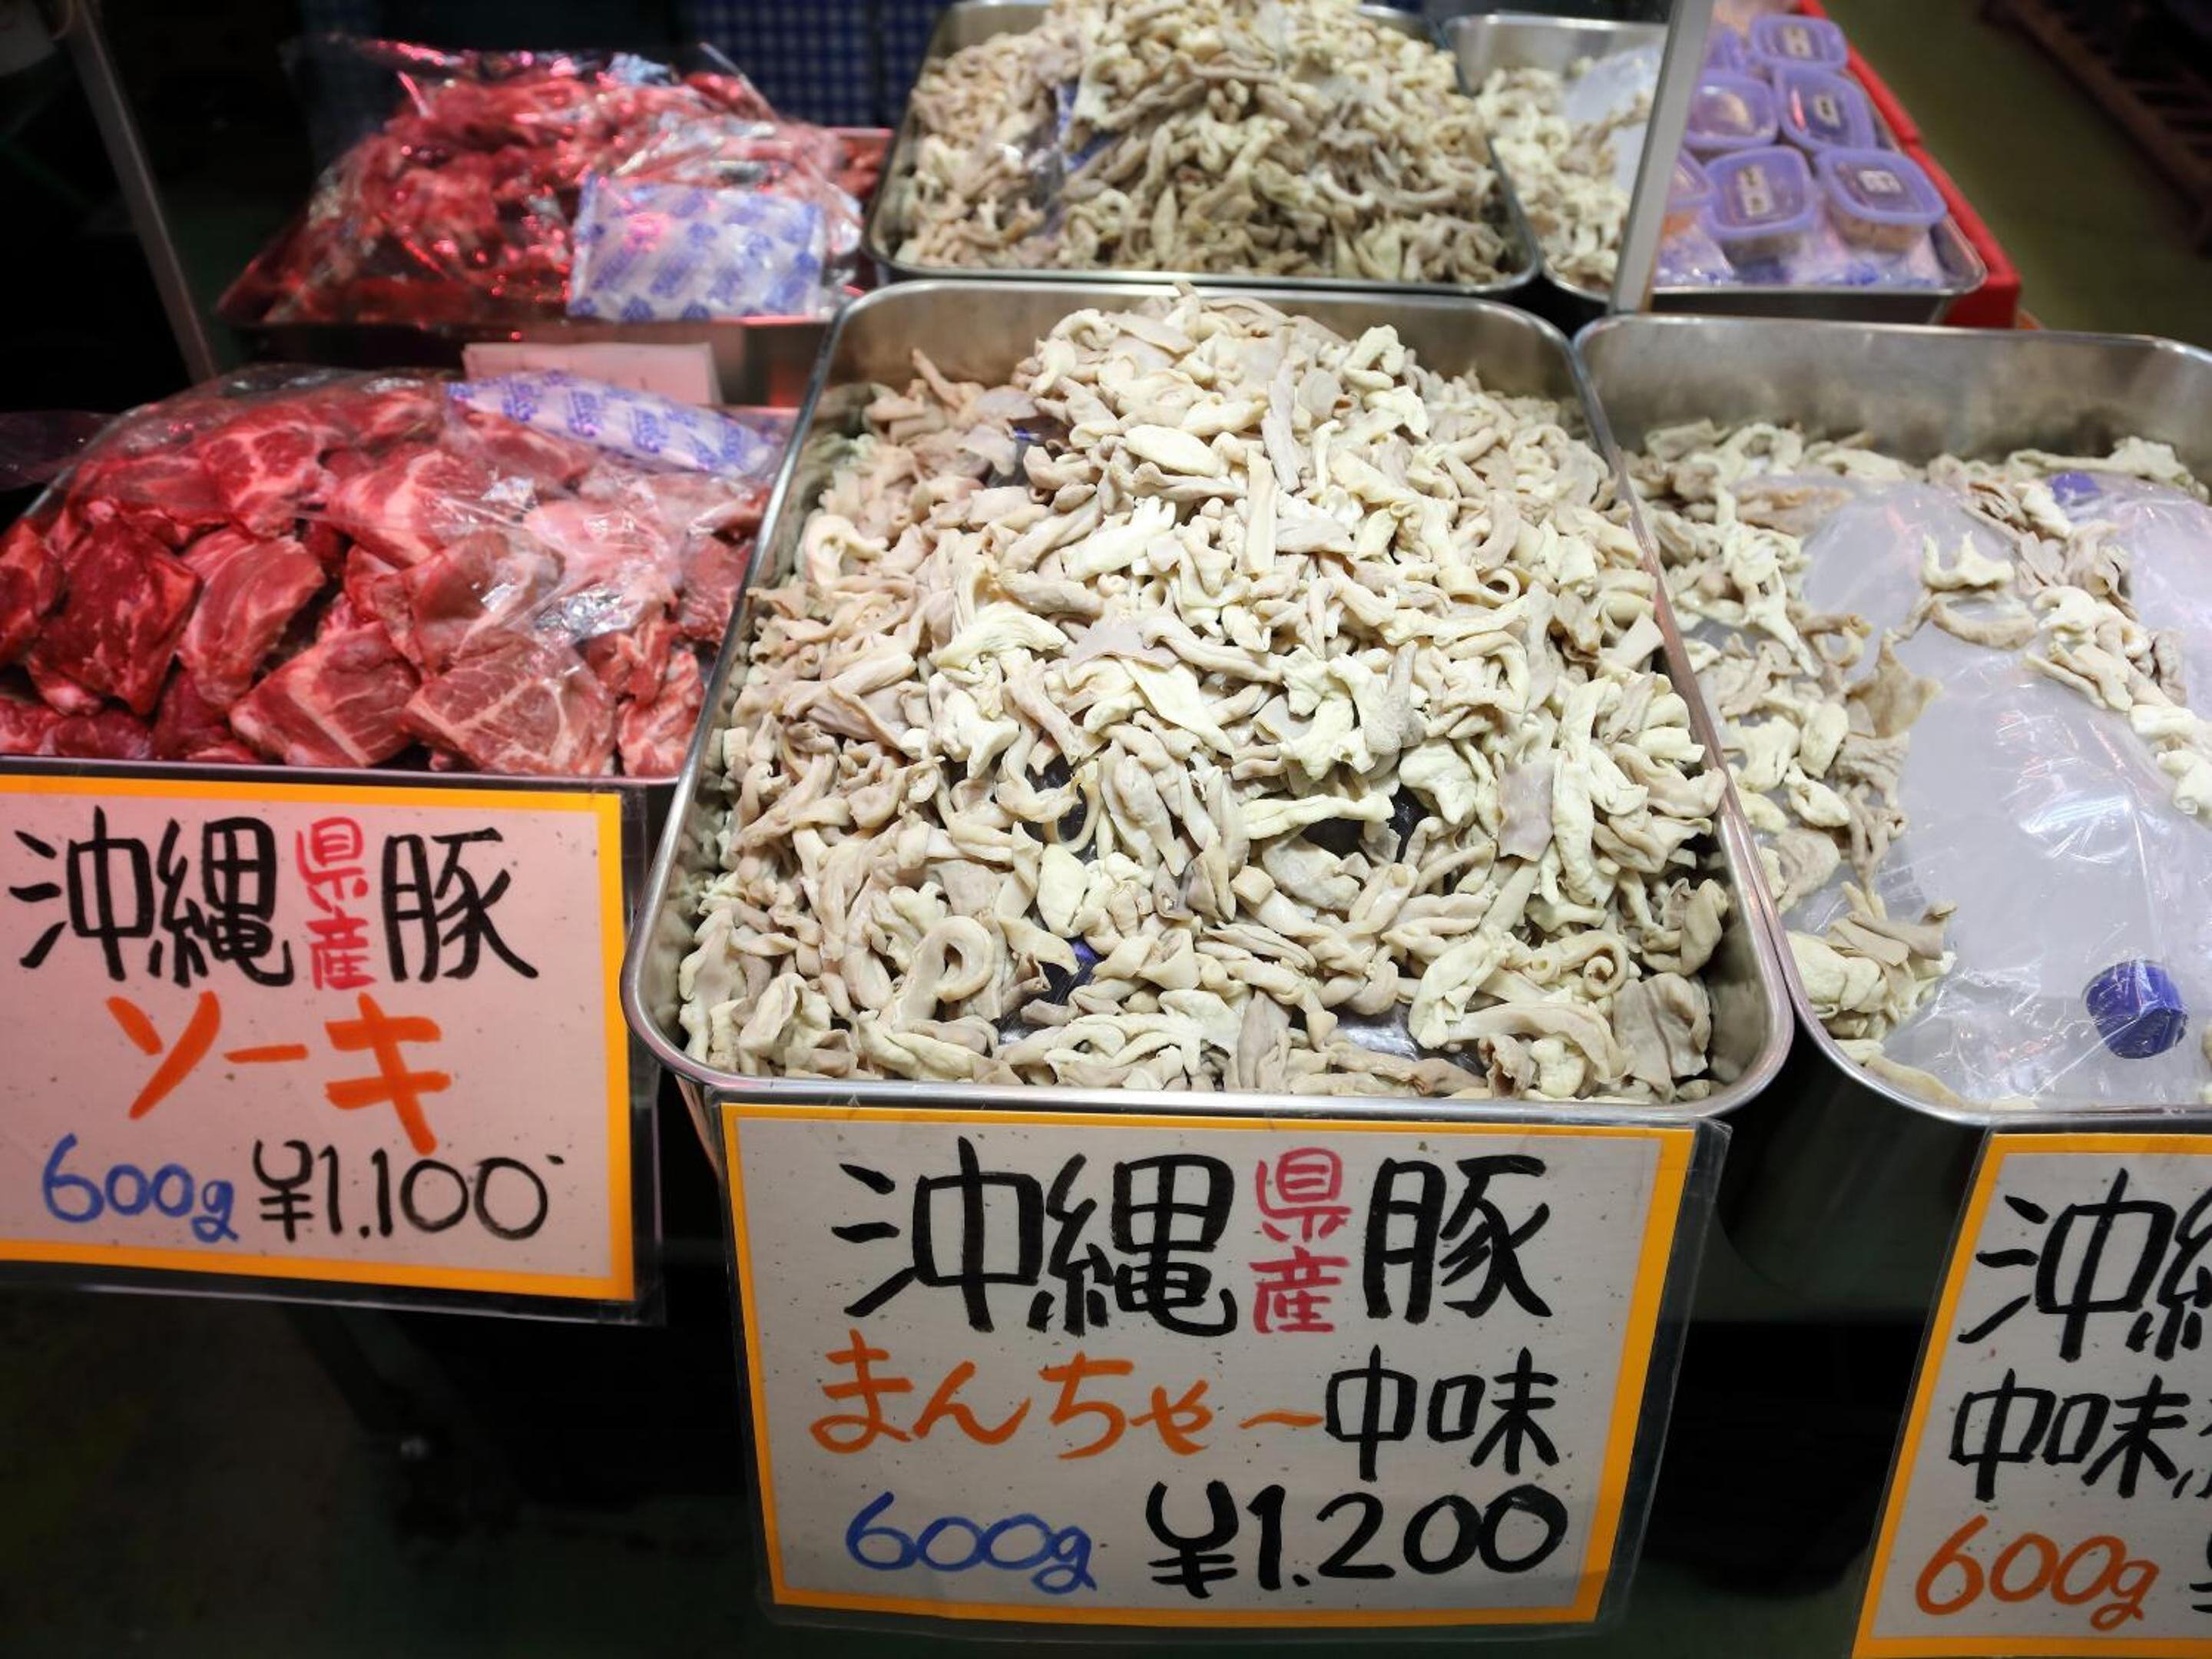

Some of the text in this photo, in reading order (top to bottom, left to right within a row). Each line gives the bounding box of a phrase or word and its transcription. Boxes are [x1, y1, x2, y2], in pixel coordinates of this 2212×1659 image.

[107, 992, 452, 1156] ソーキ
[43, 1134, 238, 1243] 600g
[1949, 1368, 2212, 1502] 中味
[846, 1480, 1568, 1599] 600g ¥1.200
[1916, 1515, 2160, 1631] 600g
